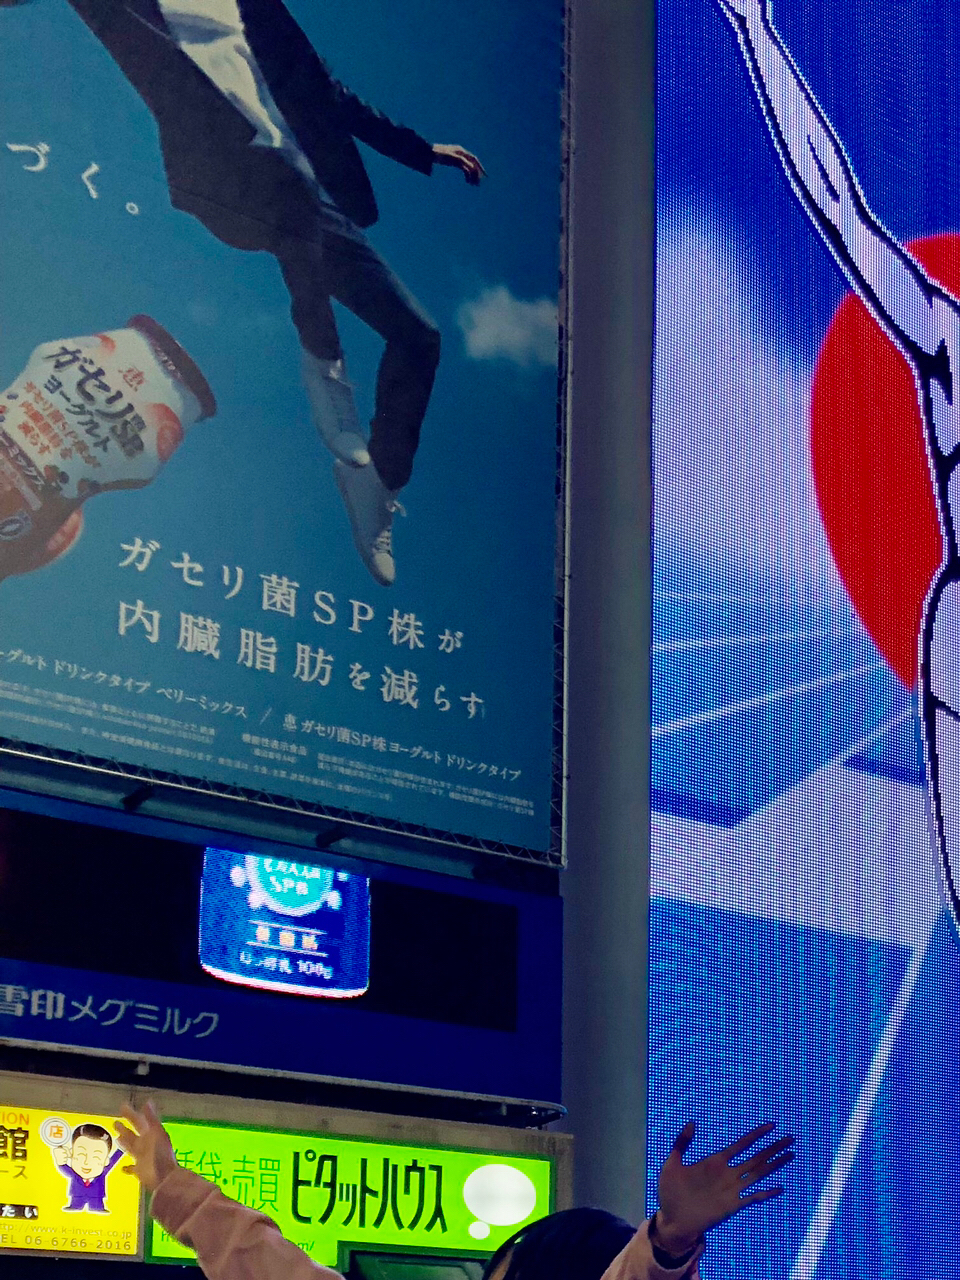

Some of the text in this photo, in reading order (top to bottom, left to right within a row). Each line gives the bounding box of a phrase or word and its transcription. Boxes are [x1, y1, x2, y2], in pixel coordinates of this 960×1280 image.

[118, 536, 465, 654] ガセリ菌SP株が
[0, 648, 47, 672] グルト
[53, 658, 152, 695] ドリンクタイプ
[155, 686, 249, 720] ベリーミックス
[117, 598, 485, 720] 内臓脂肪を減らす
[0, 983, 220, 1038] 雪印メグミルク
[0, 1112, 30, 1126] ION
[48, 1125, 64, 1140] 店
[291, 1148, 449, 1235] ピタットハウス
[0, 1222, 133, 1240] ttp://www.k-invest.co.jp
[0, 1234, 132, 1251] EL 06-6766-2016
